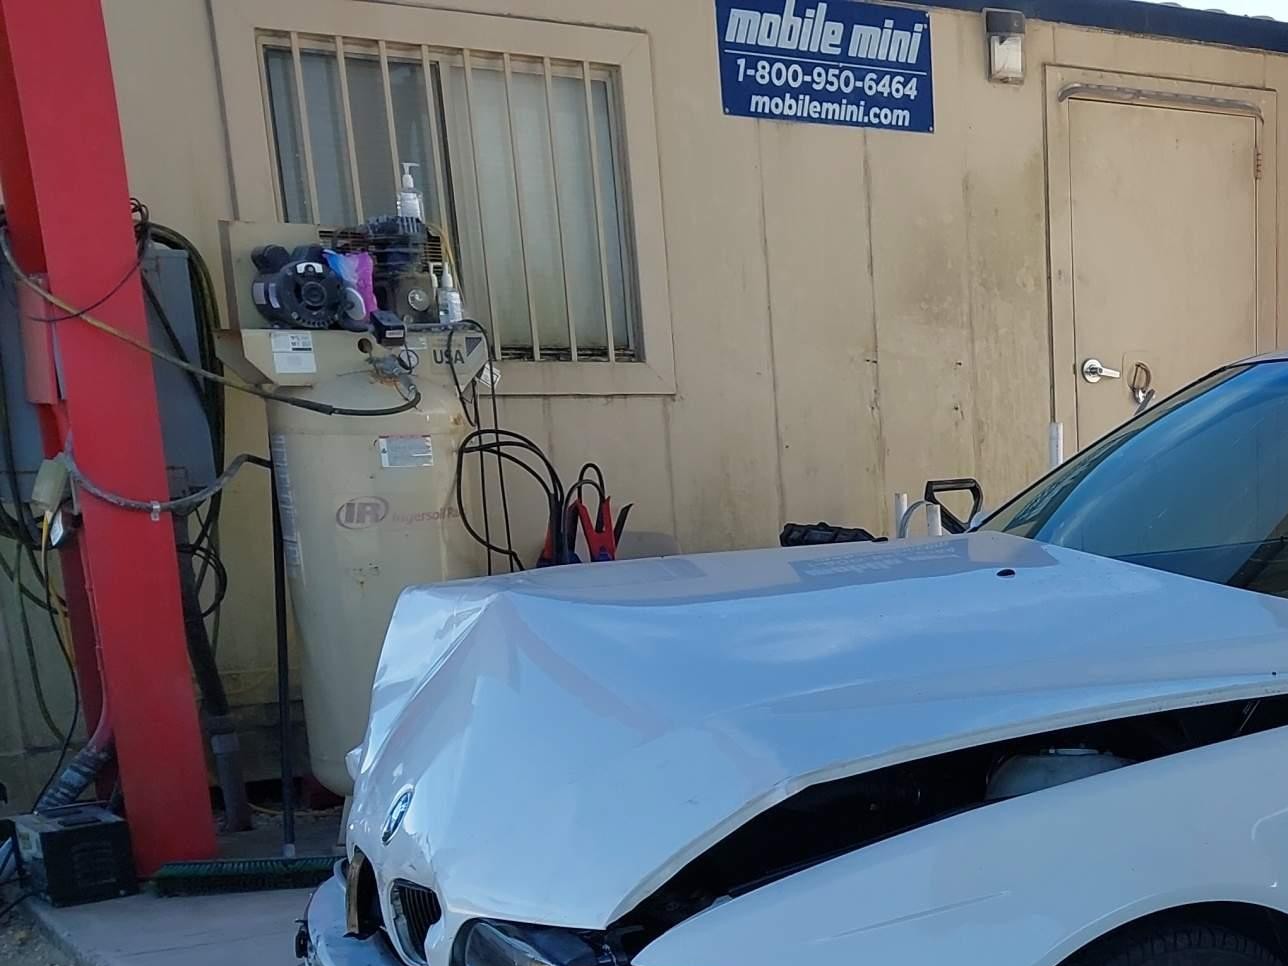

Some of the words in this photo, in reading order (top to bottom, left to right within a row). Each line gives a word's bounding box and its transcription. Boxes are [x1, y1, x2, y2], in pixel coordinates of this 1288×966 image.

[725, 0, 844, 55] mobile
[848, 19, 924, 64] mini
[736, 58, 918, 100] 1-800-950-6464
[750, 93, 910, 127] mobilemini.com
